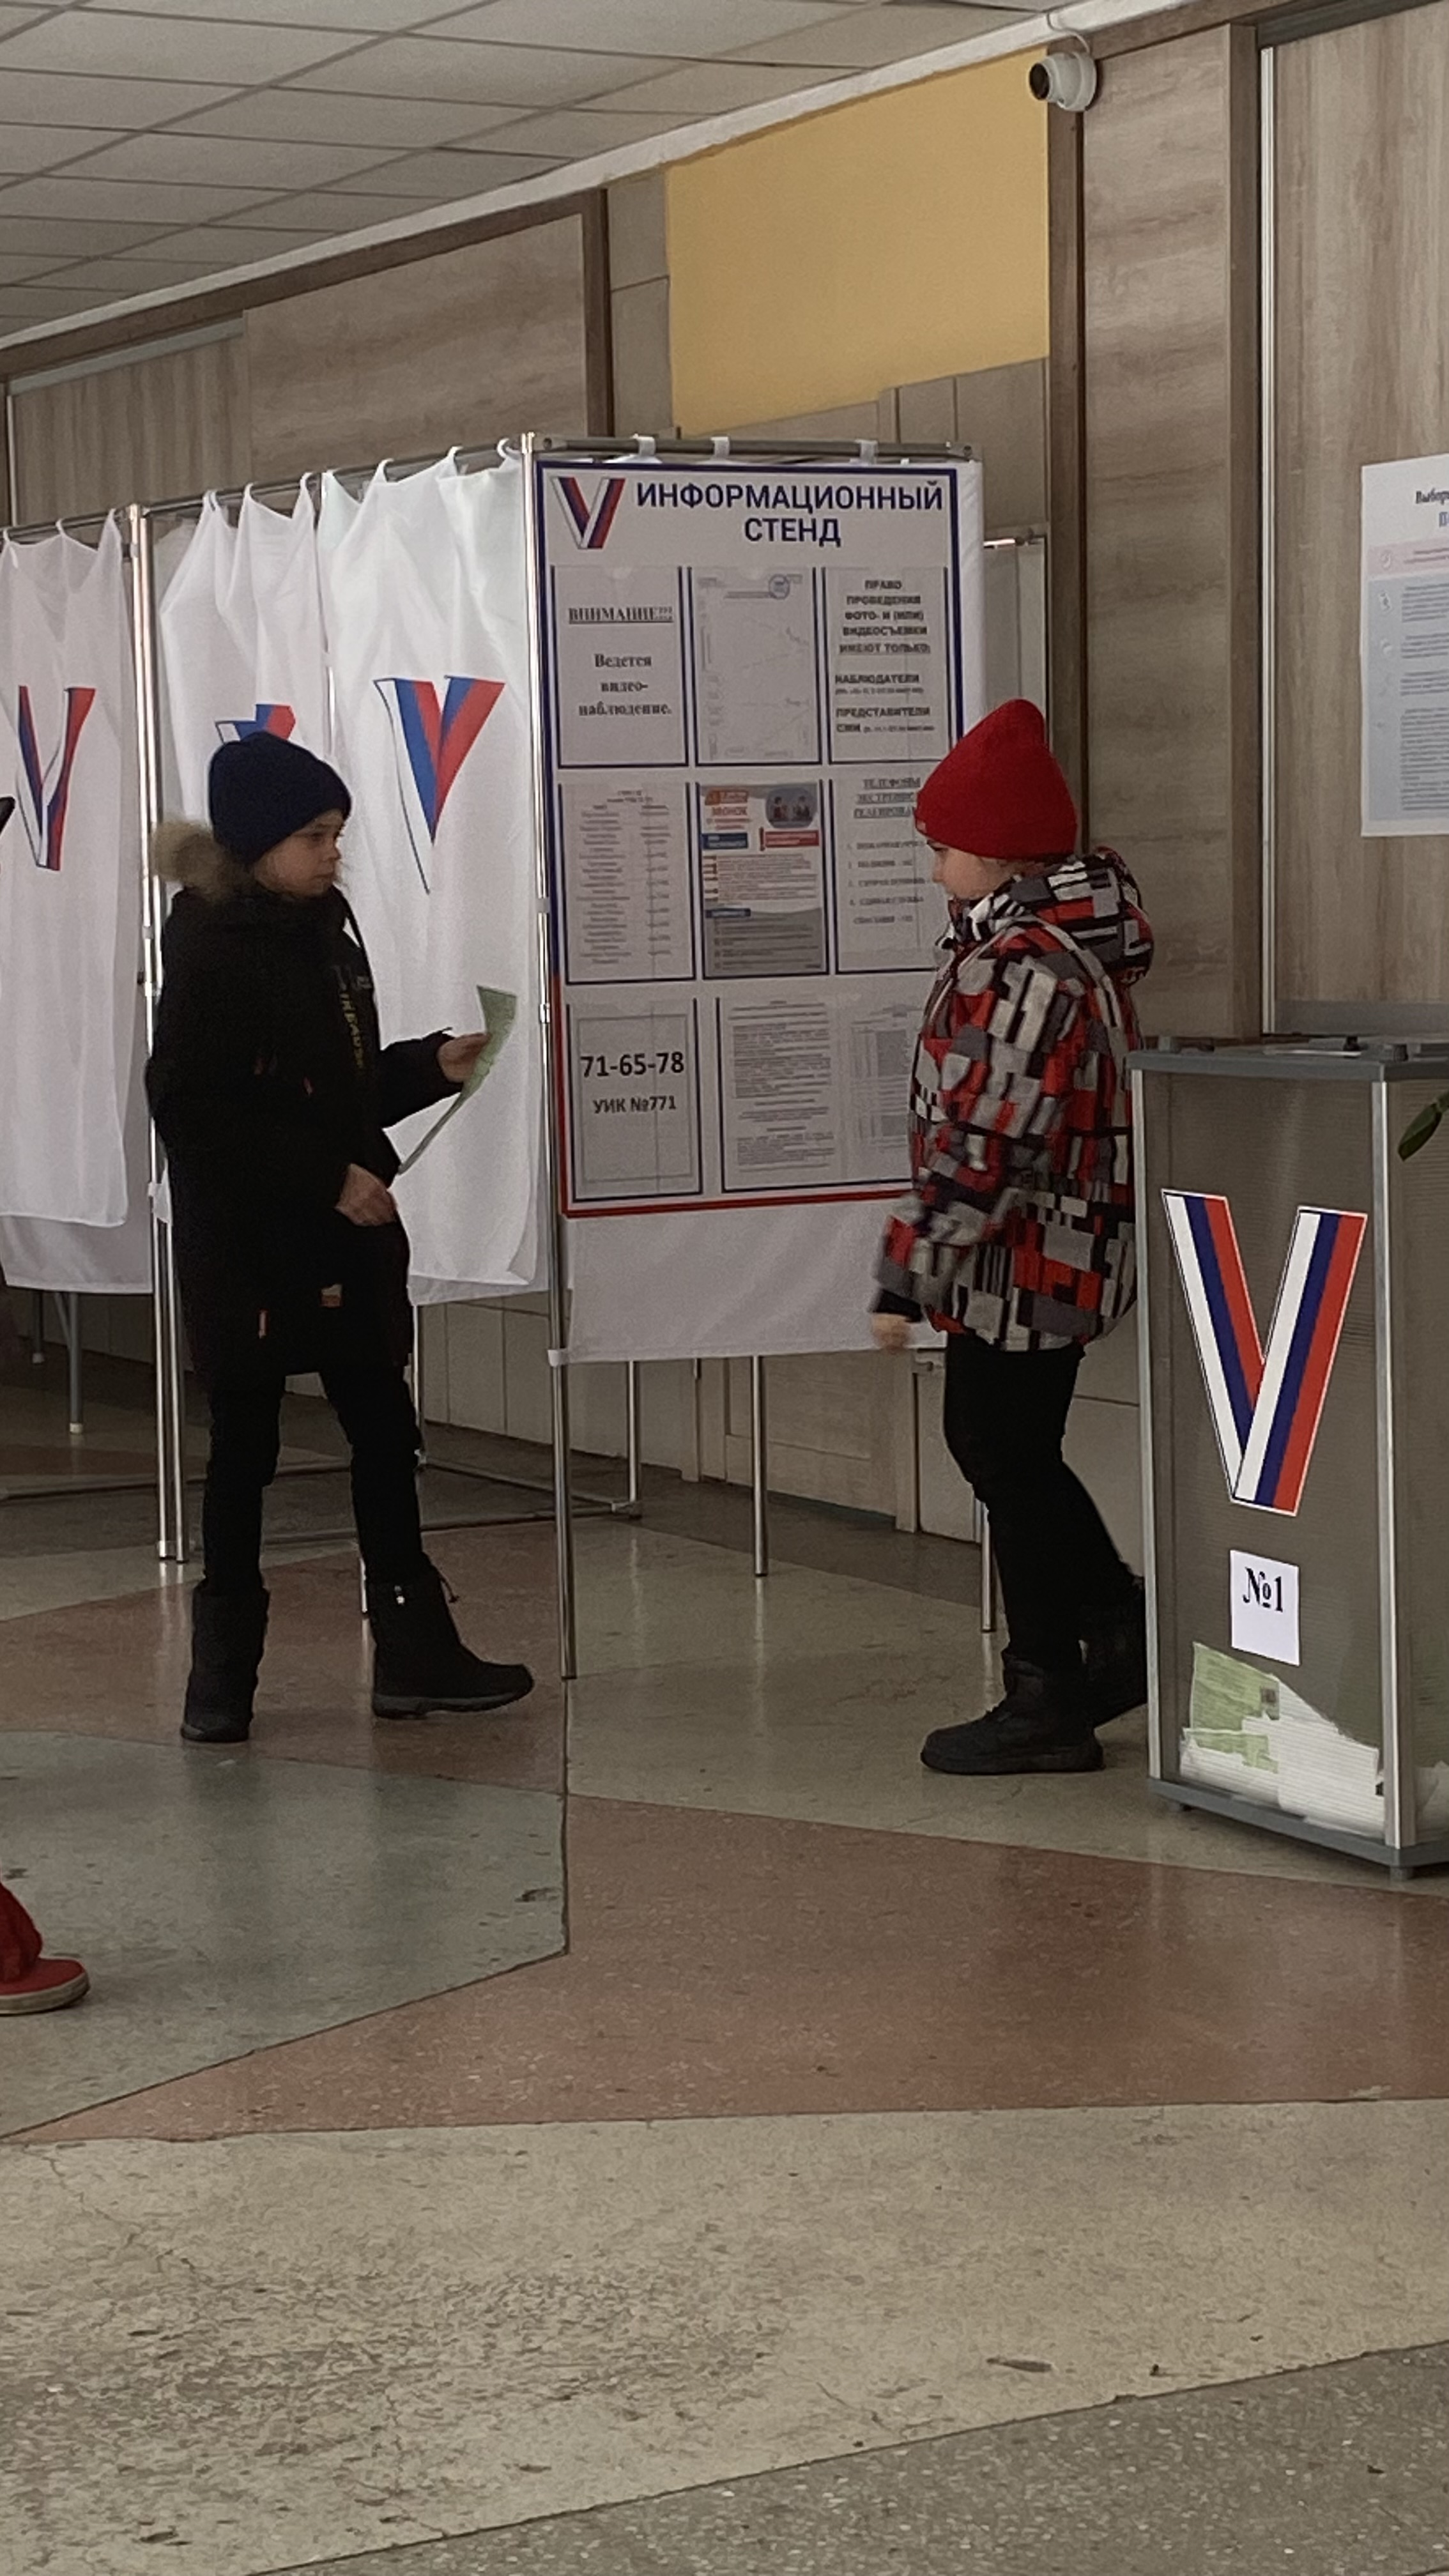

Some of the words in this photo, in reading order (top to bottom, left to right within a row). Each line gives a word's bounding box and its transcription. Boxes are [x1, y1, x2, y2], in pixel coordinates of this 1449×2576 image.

[636, 480, 944, 513] ИНФОРМАЦИОННЫЙ
[744, 517, 841, 548] СТЕНД
[864, 579, 902, 590] ПРАВО
[594, 653, 652, 668] Ведется
[601, 680, 648, 693] видео-
[834, 673, 919, 684] НАБЛЮДАТЕЛИ
[836, 707, 931, 718] ПРЕДСТАВИТЕЛИ
[579, 1051, 684, 1078] 71-65-78
[593, 1098, 626, 1114] УИК
[630, 1094, 677, 1113] №771
[1243, 1566, 1284, 1613] №1
